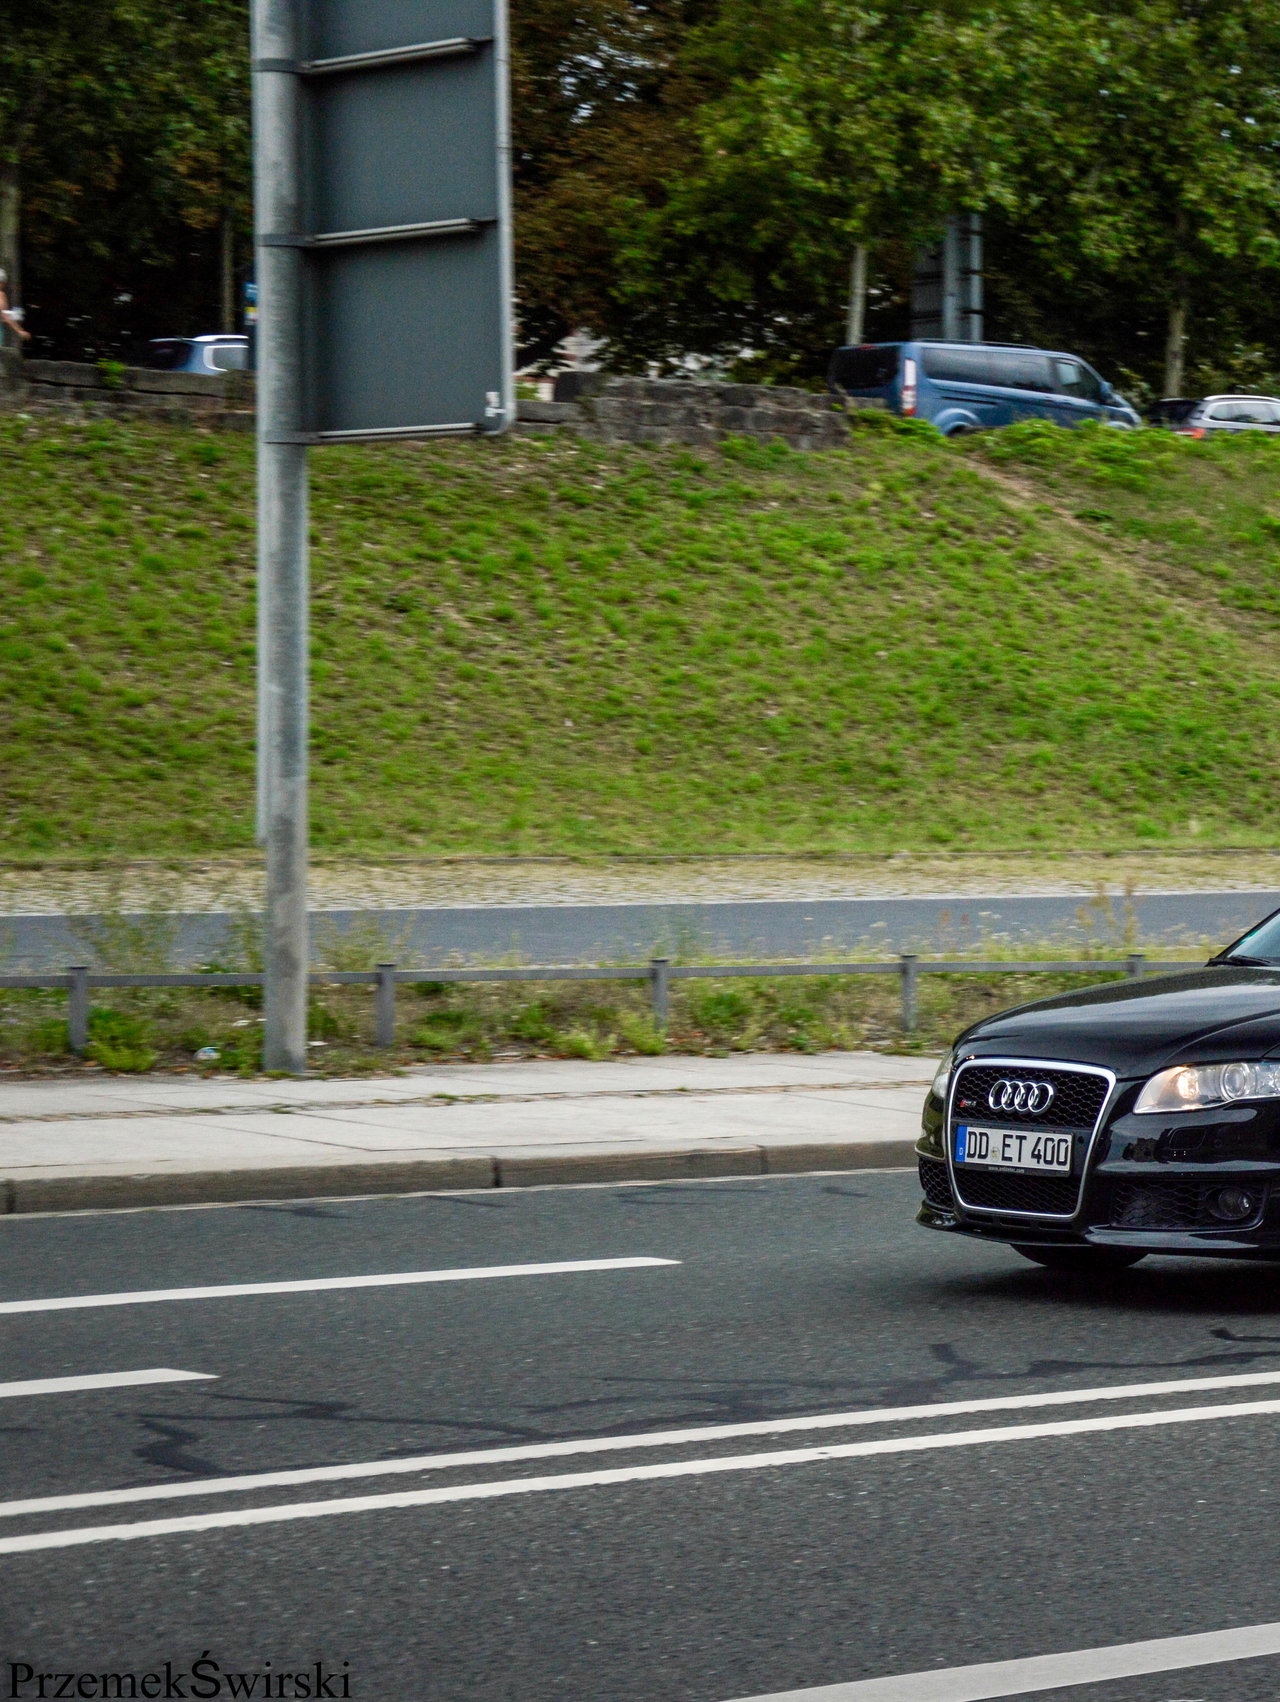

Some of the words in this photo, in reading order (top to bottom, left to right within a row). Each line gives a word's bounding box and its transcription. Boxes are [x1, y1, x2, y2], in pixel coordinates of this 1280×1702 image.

[967, 1131, 989, 1159] DD
[1001, 1134, 1027, 1162] ET
[1031, 1136, 1069, 1166] 400
